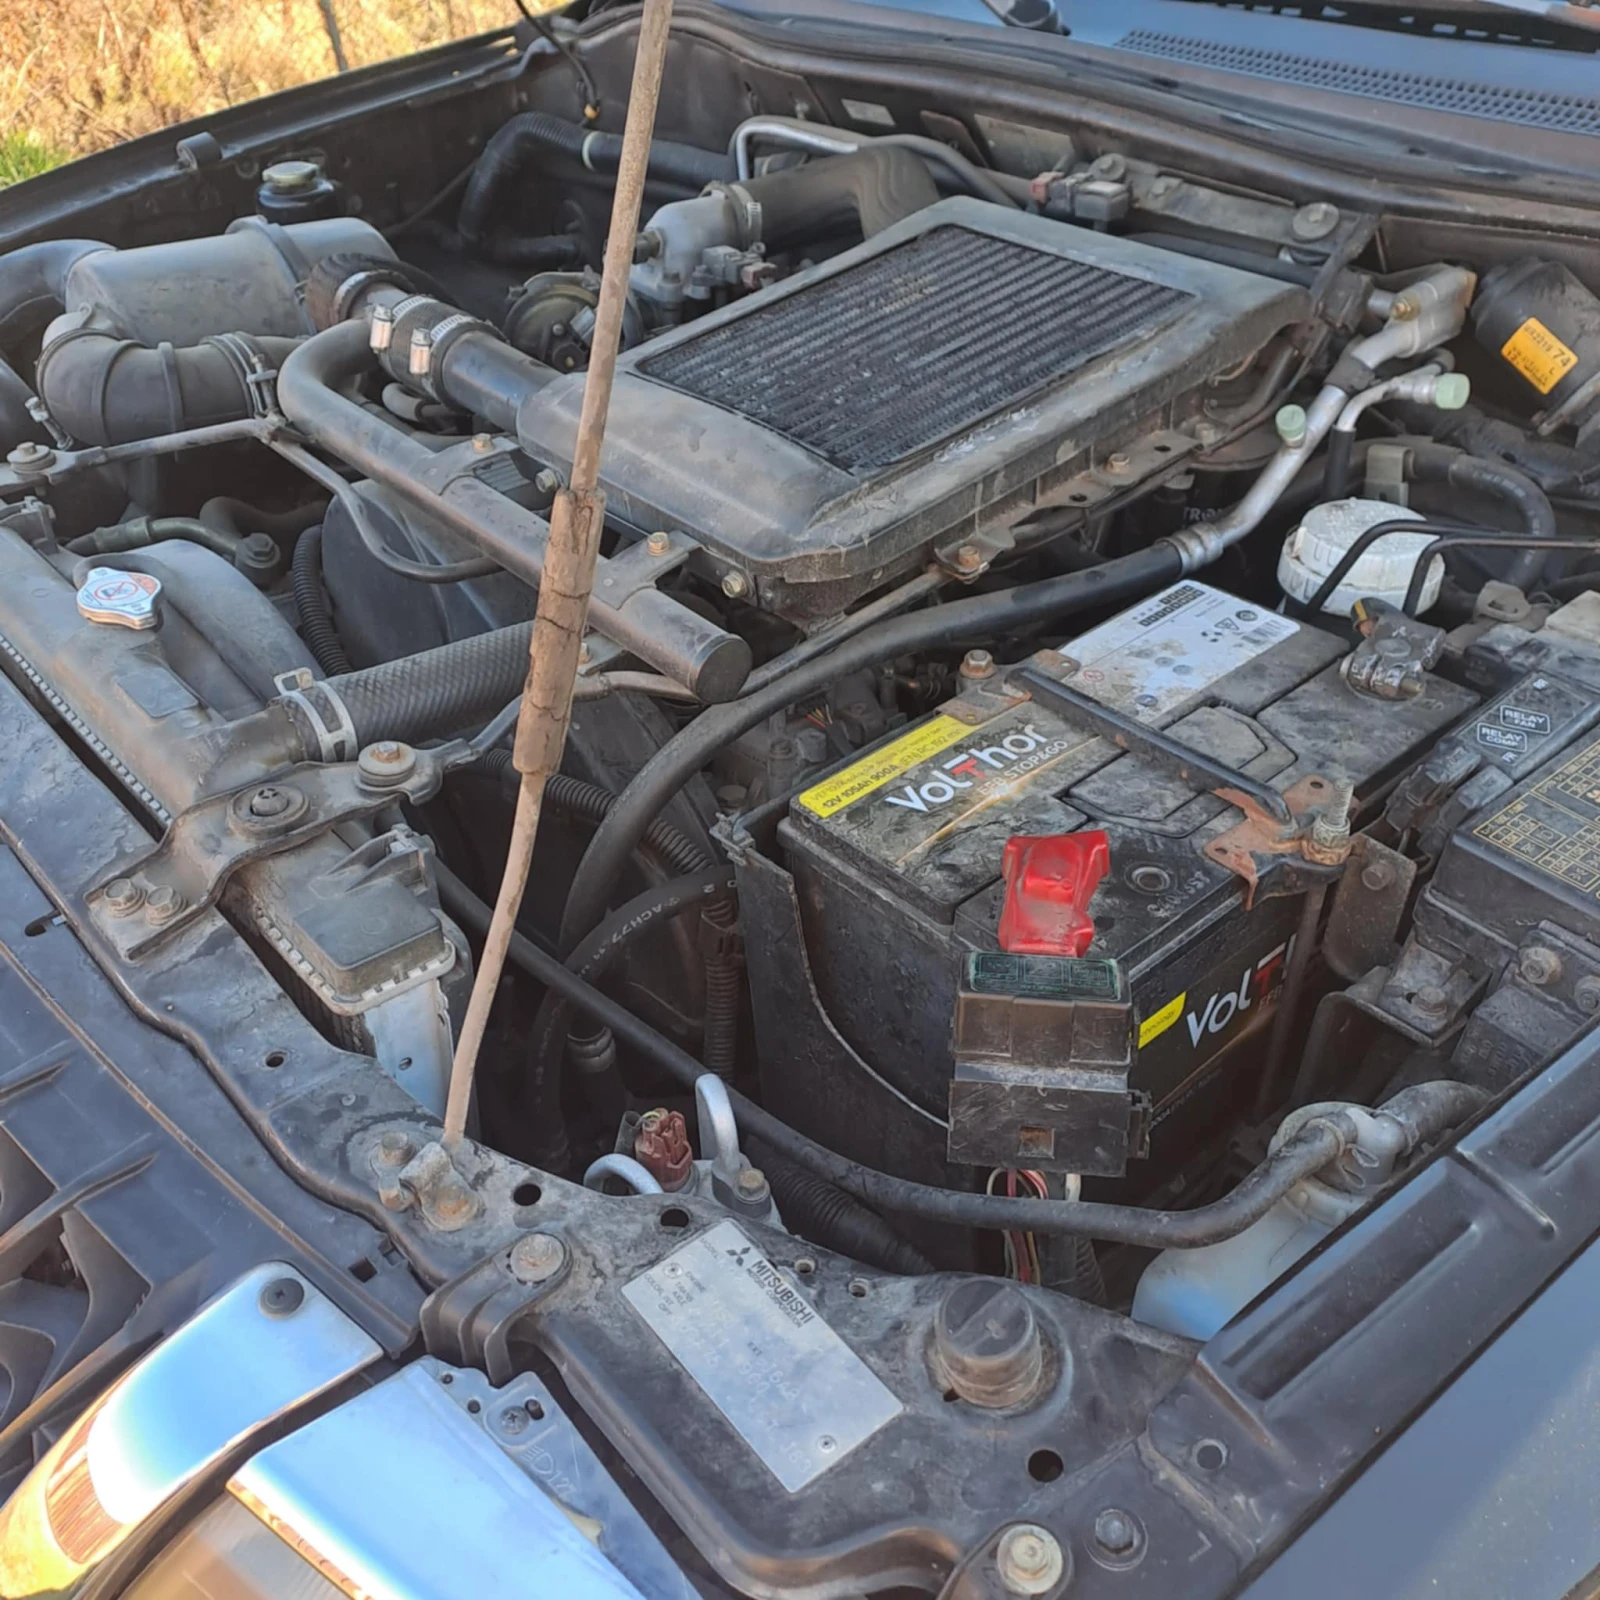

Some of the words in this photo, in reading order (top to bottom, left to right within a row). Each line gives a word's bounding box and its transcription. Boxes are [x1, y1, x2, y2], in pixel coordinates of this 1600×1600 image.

[1504, 709, 1545, 724] RELAY
[1514, 719, 1536, 728] FAN
[1481, 727, 1522, 742] RELAY
[1486, 735, 1519, 747] COMP
[1007, 739, 1069, 782] STOP&GO
[701, 1238, 718, 1259] MODEL
[746, 1268, 766, 1289] MOTORS
[766, 1289, 802, 1328] CORPORATION
[751, 1260, 815, 1324] MITSUBISHI
[685, 1271, 706, 1293] ENGINE
[747, 1341, 762, 1357] EXT
